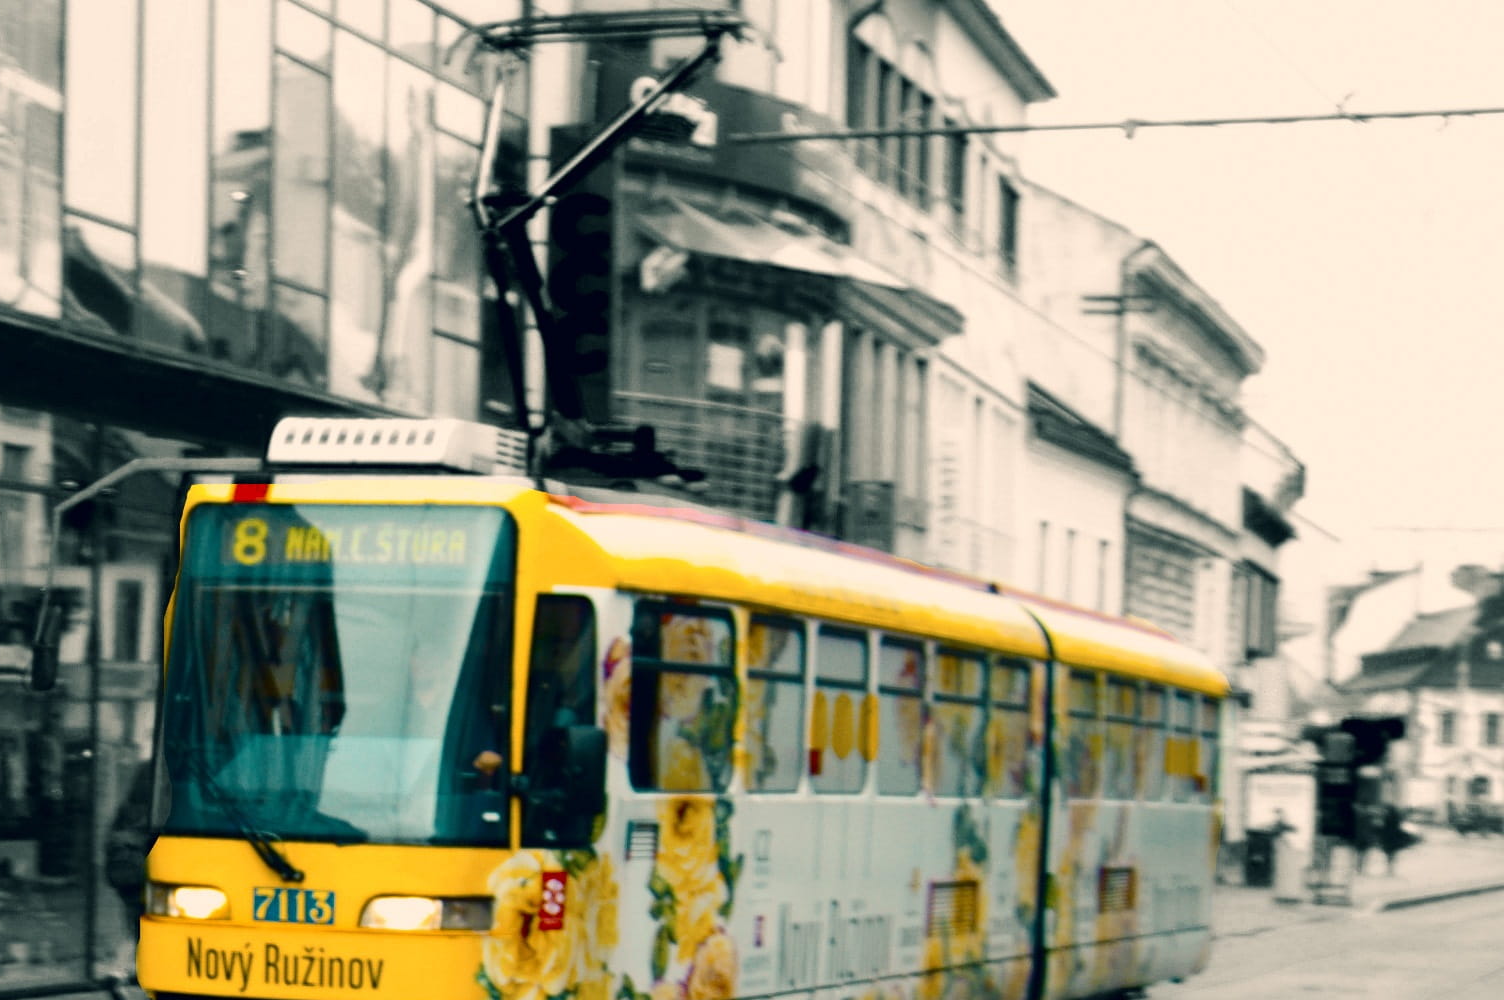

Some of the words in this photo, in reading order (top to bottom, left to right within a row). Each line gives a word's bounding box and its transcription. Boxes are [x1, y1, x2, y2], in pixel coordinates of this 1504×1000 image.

[233, 518, 269, 566] 8
[254, 887, 334, 925] 7113
[187, 937, 254, 993] Nový
[264, 943, 385, 989] Ružinov
